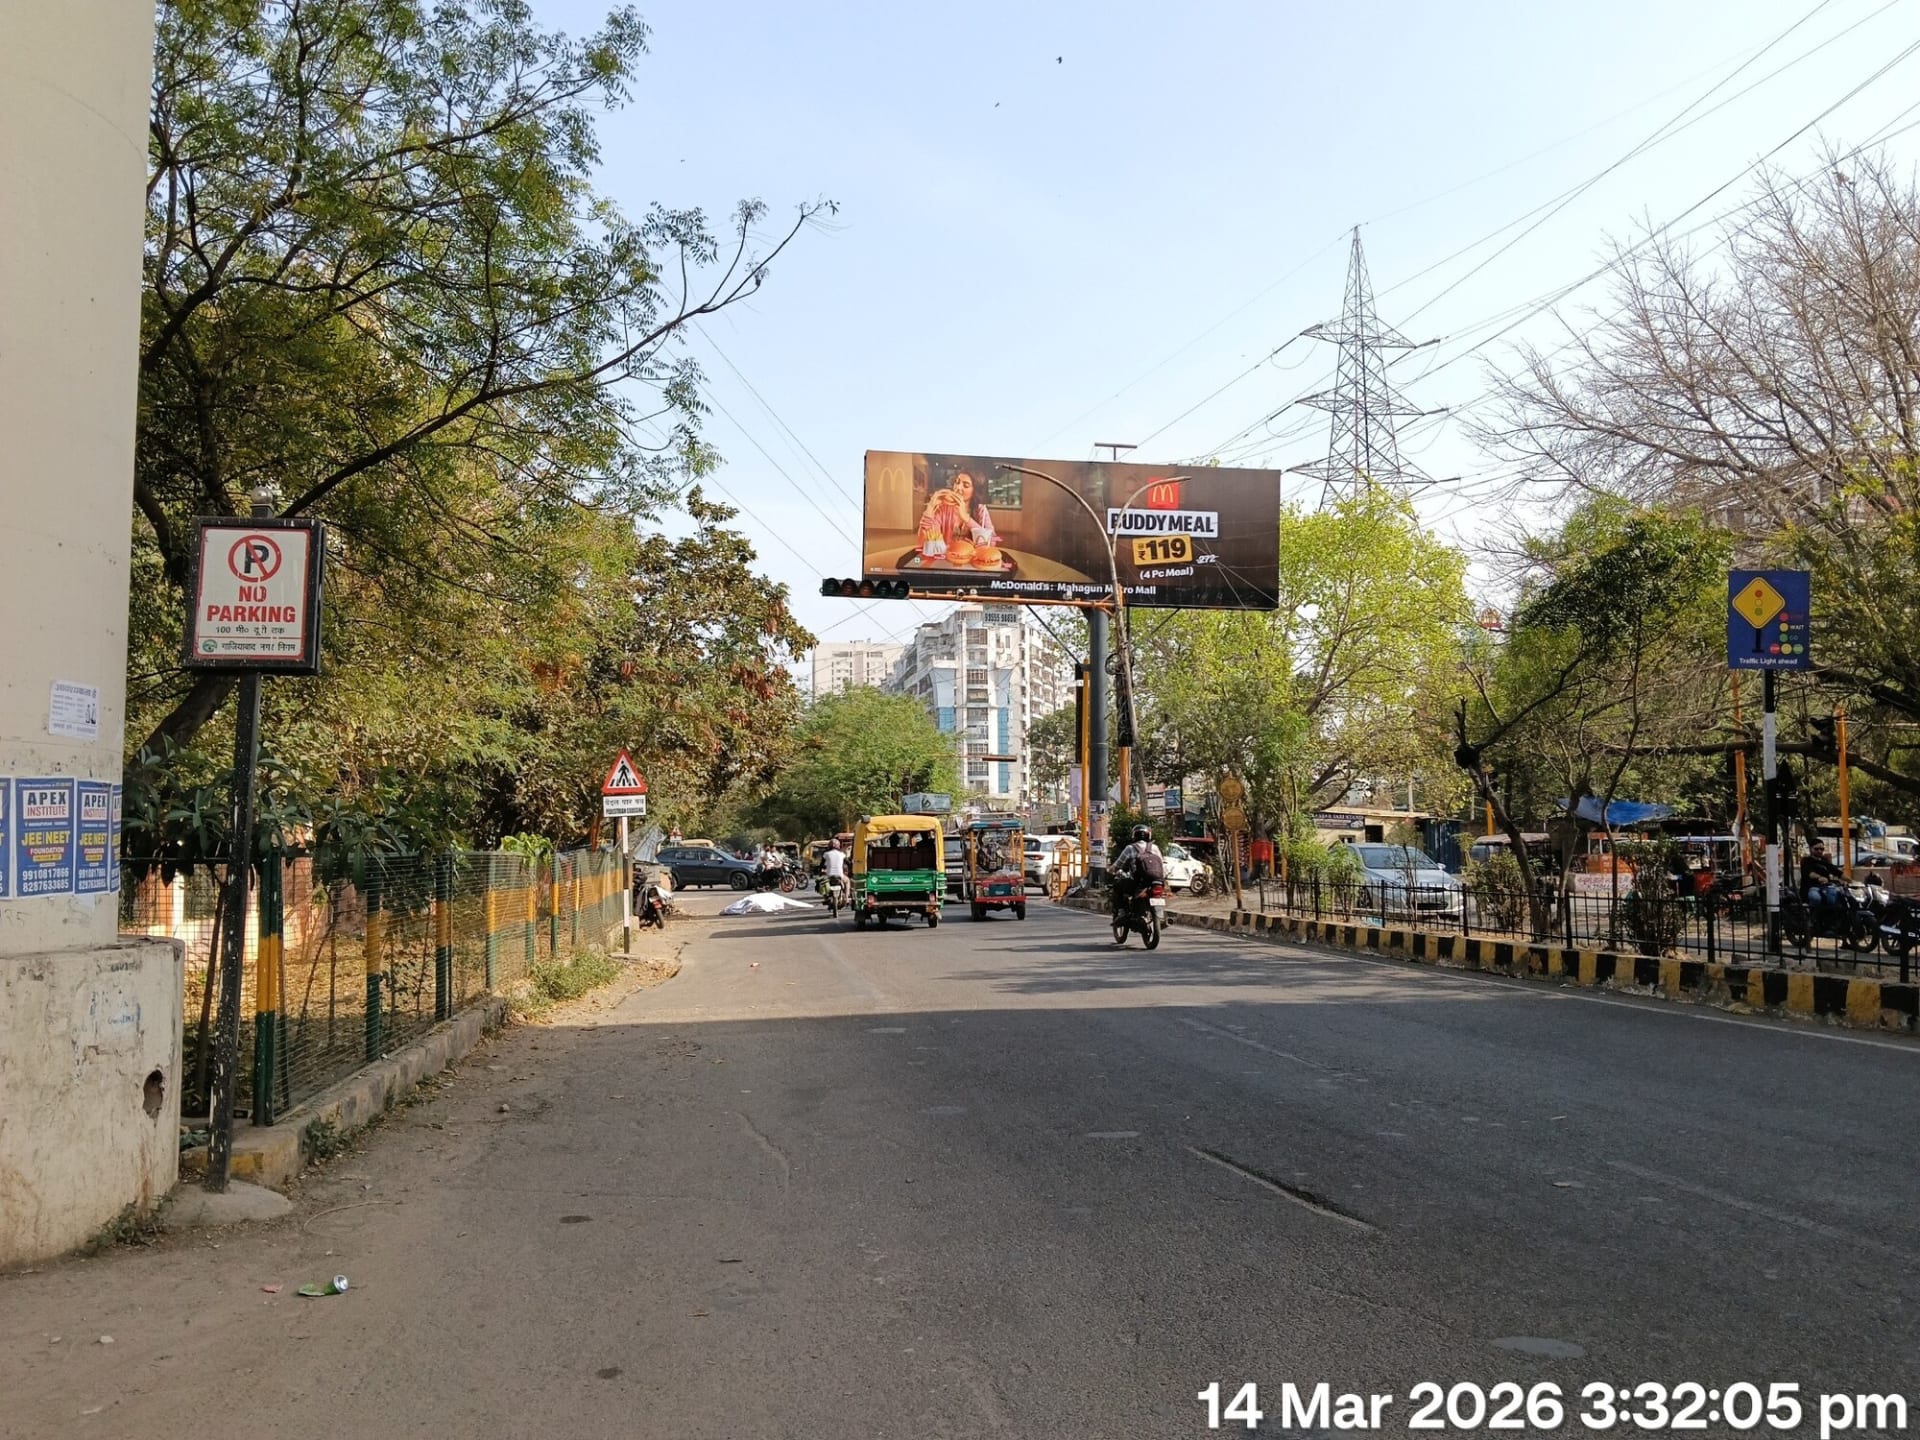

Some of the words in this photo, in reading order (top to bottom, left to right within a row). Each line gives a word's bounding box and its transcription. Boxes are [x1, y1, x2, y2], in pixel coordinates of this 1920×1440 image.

[1152, 569, 1164, 578] Pc
[1166, 566, 1194, 577] Meal)
[238, 585, 267, 603] NO
[1057, 583, 1103, 595] Mahagun
[1104, 584, 1133, 594] Mro
[1135, 586, 1157, 595] Mall
[206, 605, 296, 623] PARKING
[216, 626, 231, 634] 100
[1760, 657, 1776, 665] Light
[27, 791, 66, 806] APEX
[84, 794, 106, 808] APEX
[27, 805, 66, 817] INSTITUTE
